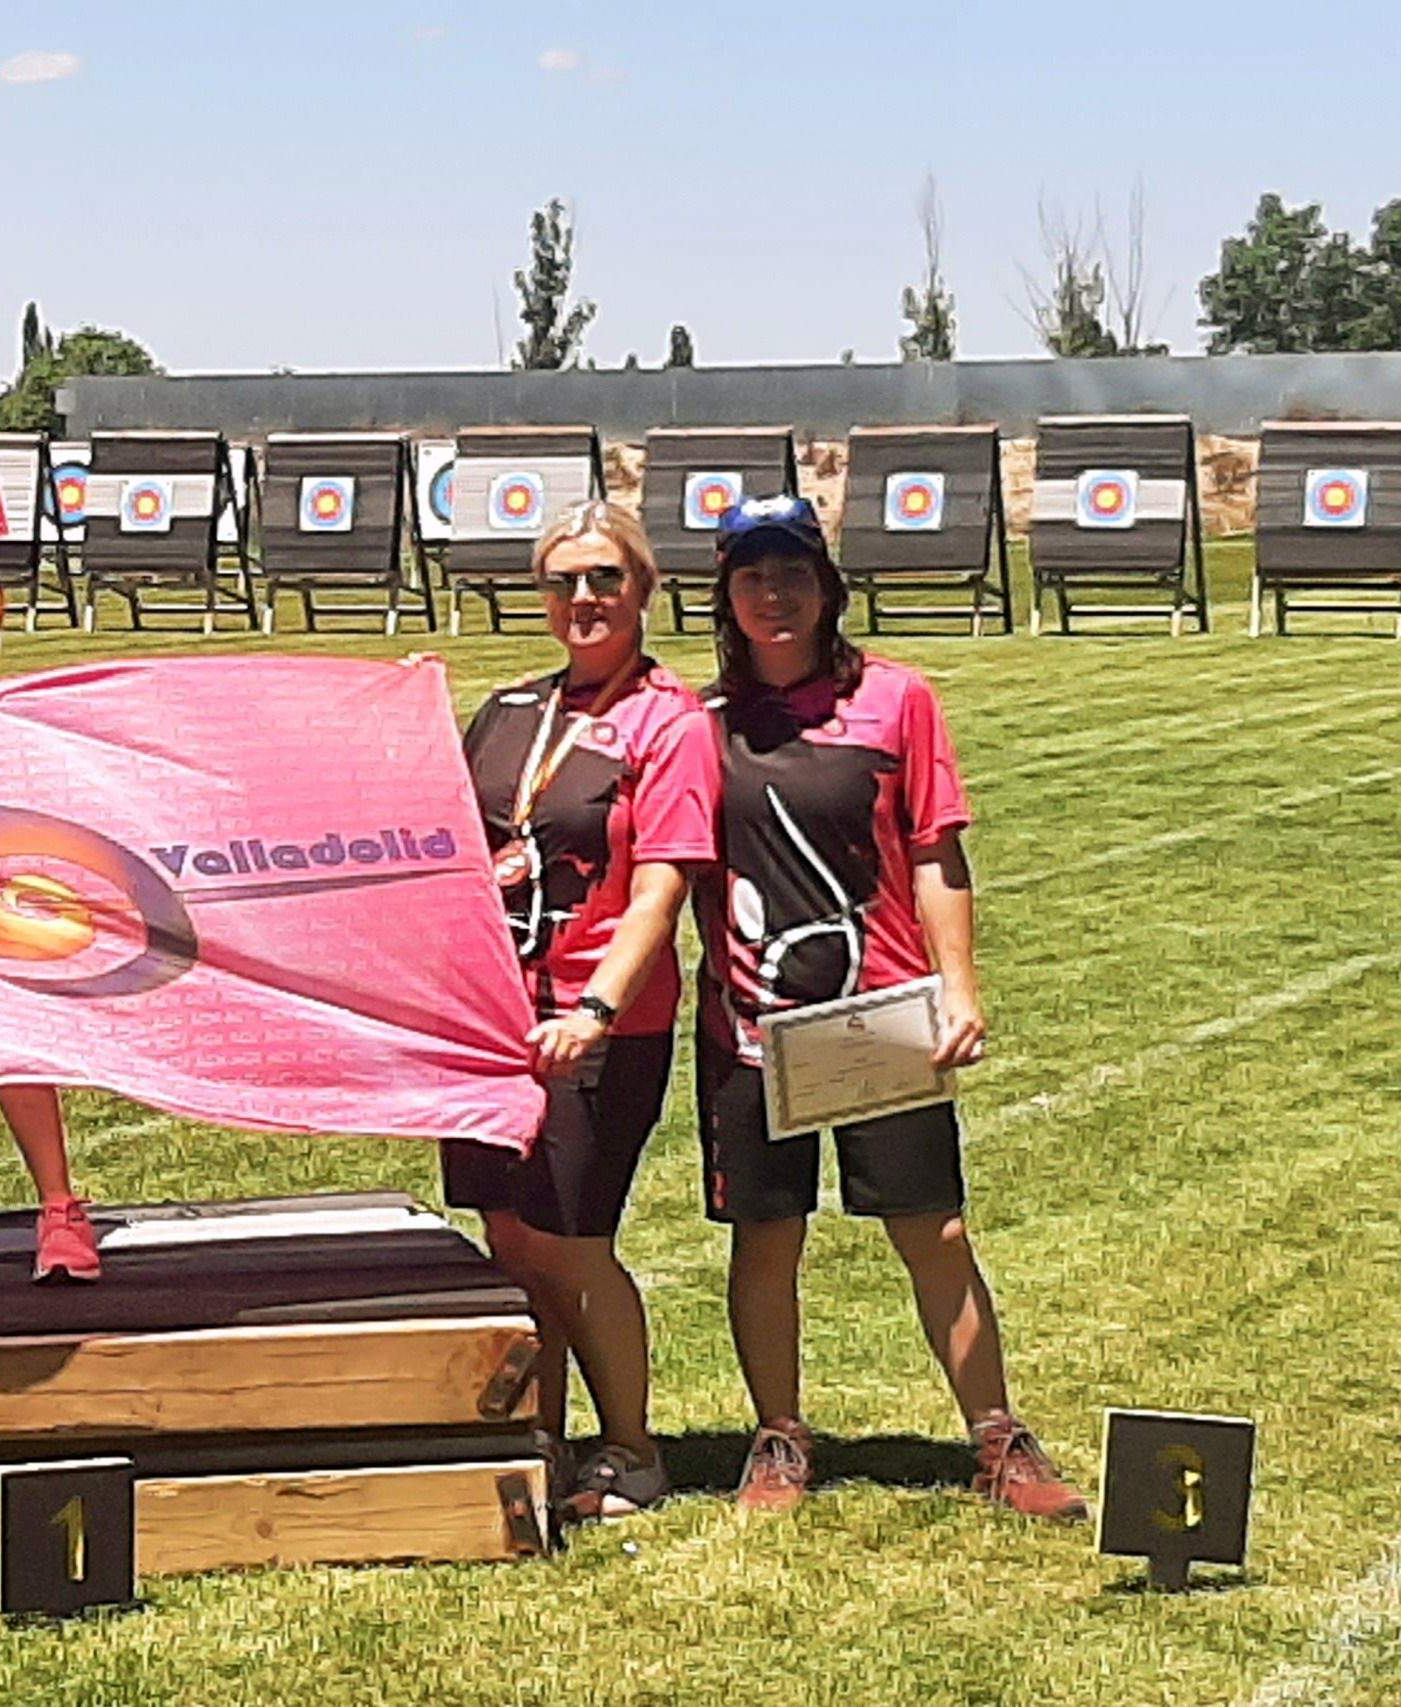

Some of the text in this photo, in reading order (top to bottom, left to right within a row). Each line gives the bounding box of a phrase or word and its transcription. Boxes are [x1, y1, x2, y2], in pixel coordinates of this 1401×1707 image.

[150, 827, 457, 878] Valladolid
[1152, 1444, 1205, 1532] 3
[50, 1495, 85, 1580] 1
